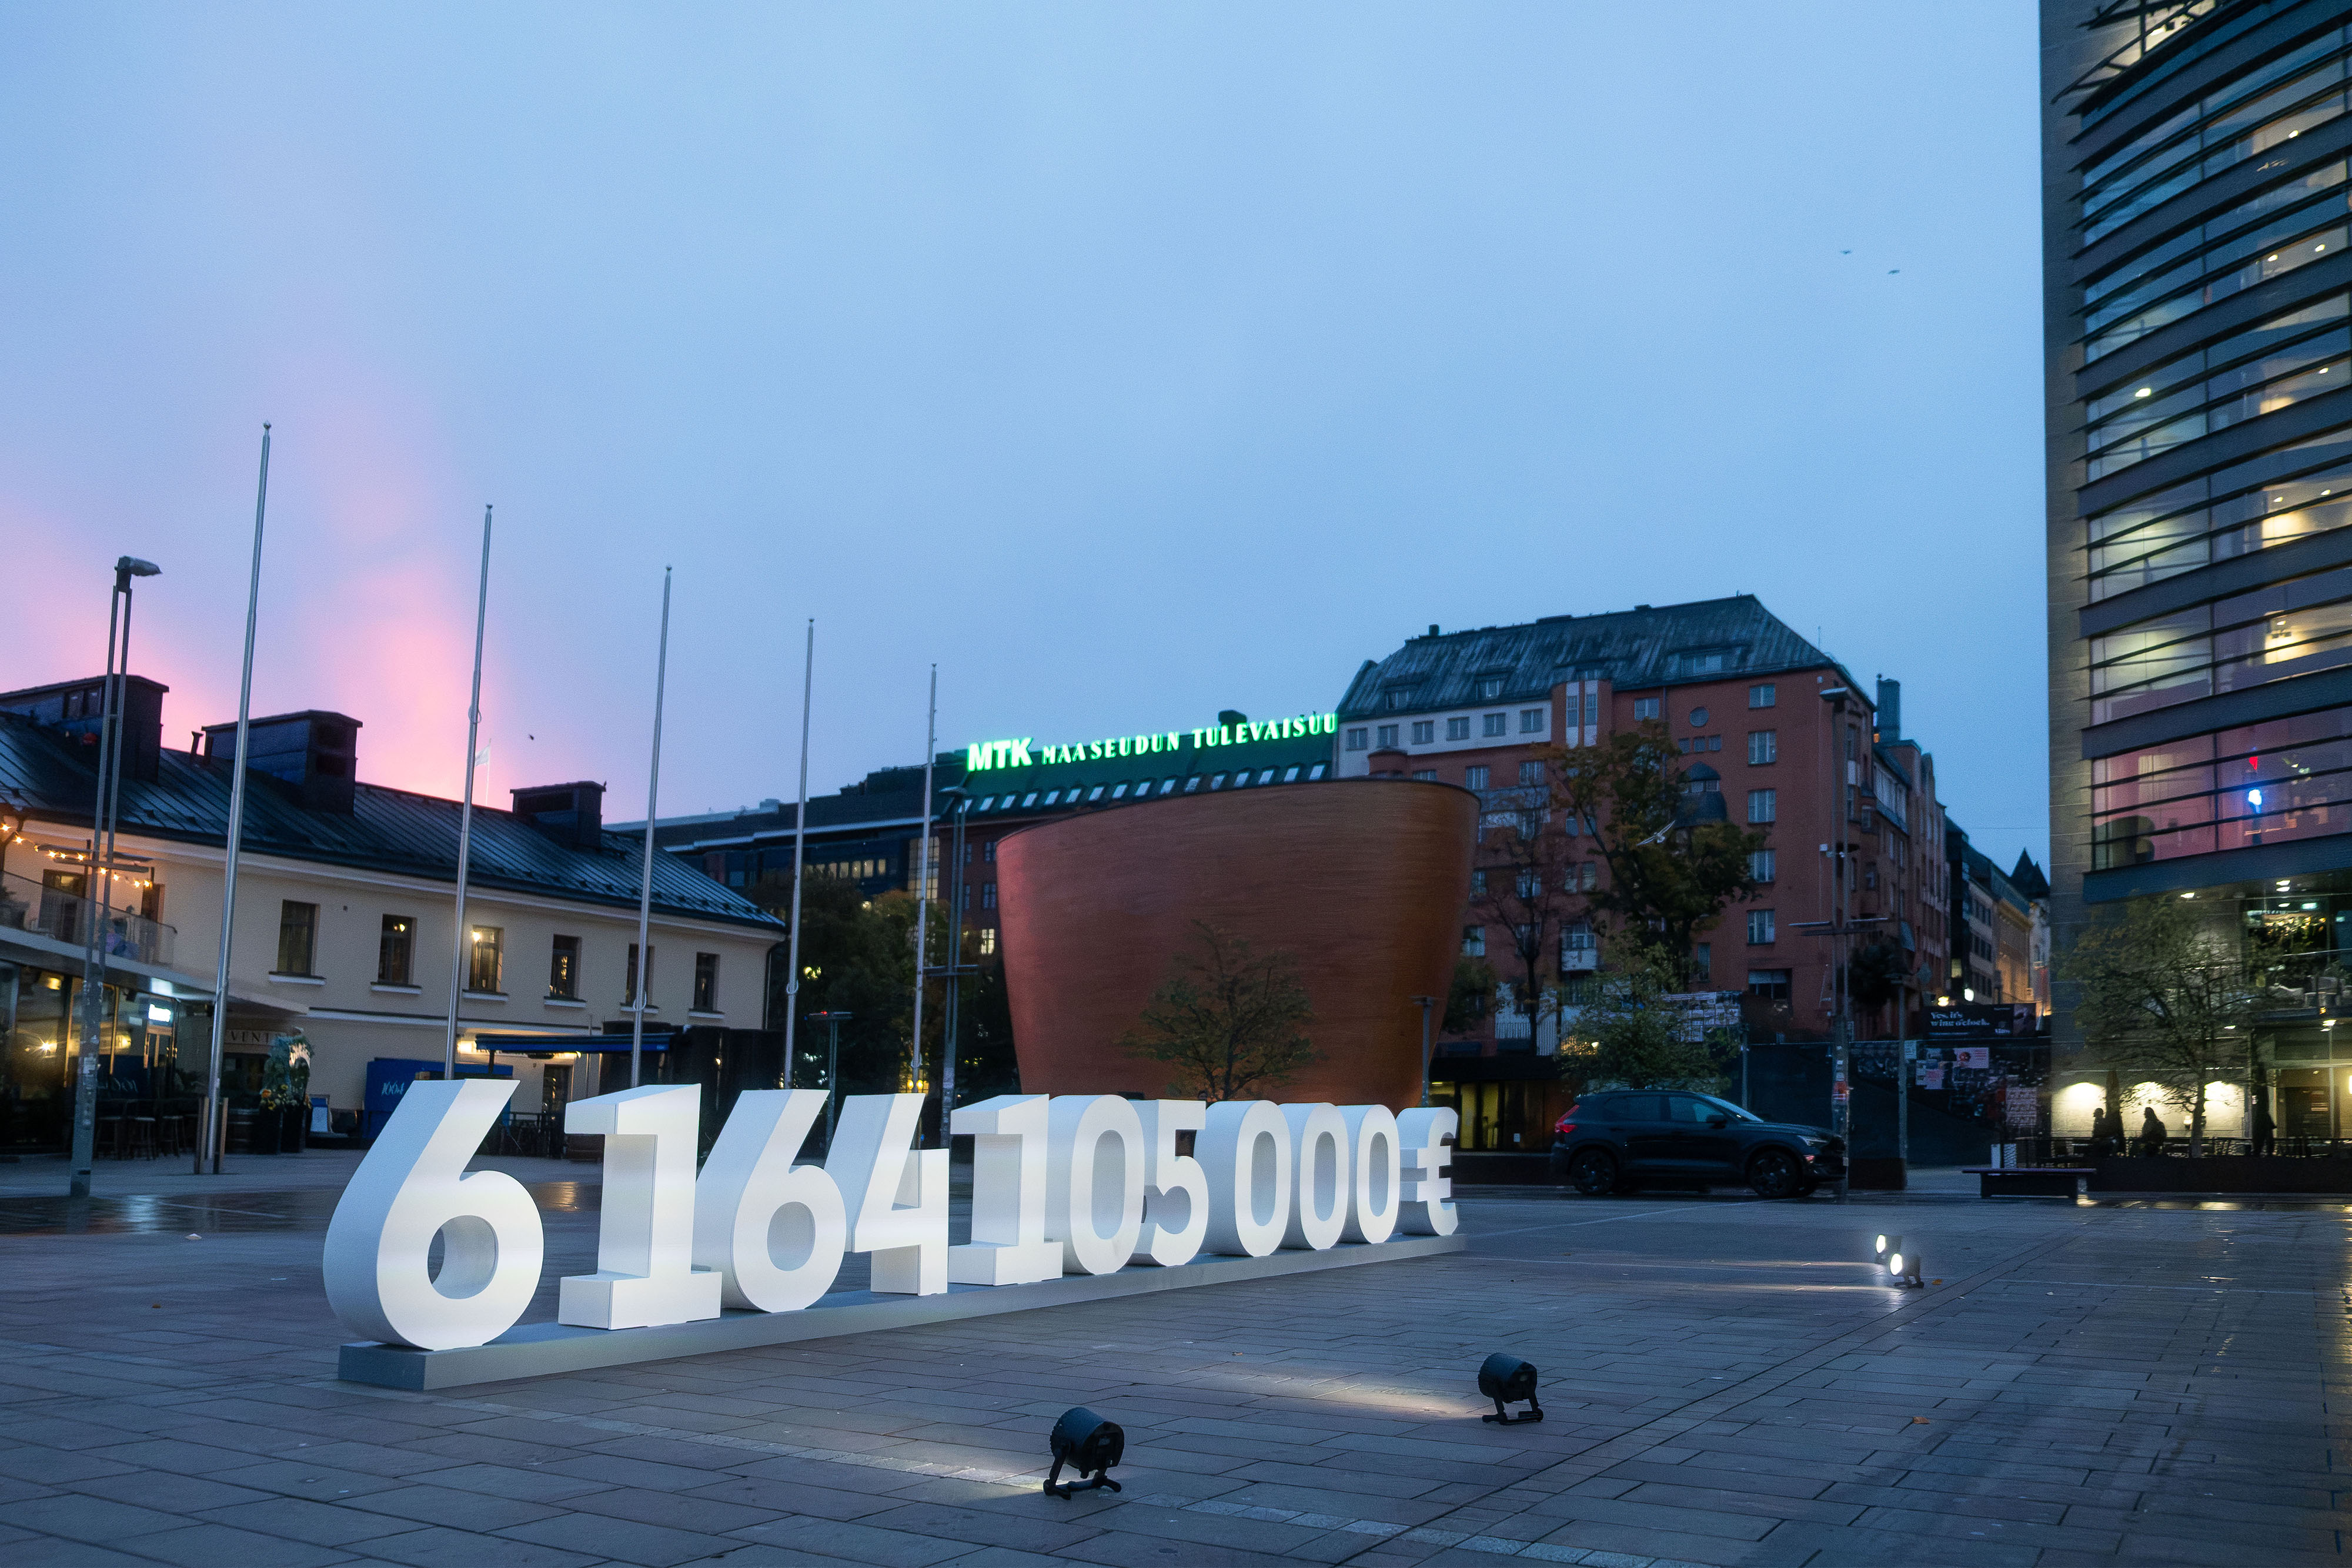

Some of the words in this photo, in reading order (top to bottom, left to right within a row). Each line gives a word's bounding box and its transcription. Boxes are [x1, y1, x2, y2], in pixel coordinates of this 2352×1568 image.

[967, 737, 1033, 772] MTK
[1041, 731, 1180, 765] MAASEUDUN
[323, 1078, 544, 1351] 6
